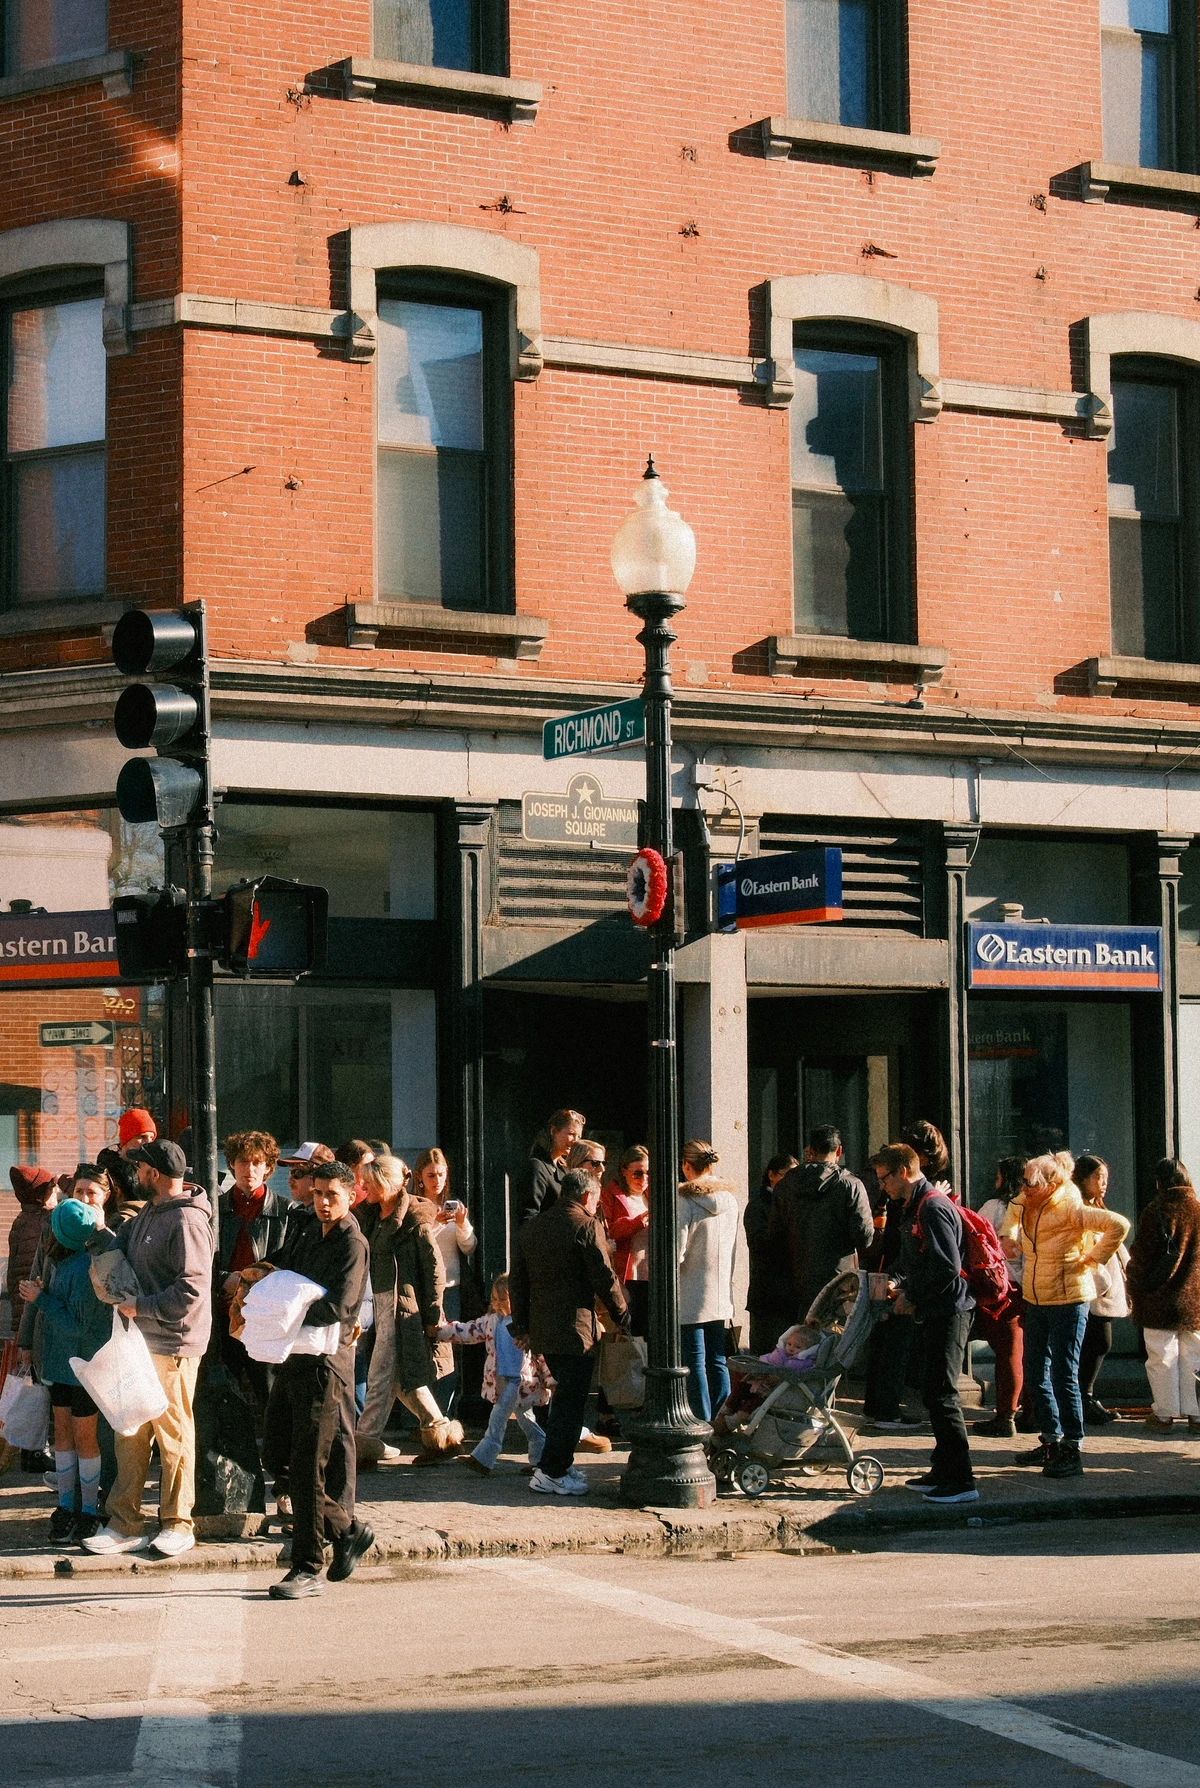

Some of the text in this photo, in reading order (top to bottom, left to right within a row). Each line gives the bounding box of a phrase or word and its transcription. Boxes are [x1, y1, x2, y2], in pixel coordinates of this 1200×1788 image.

[554, 709, 635, 755] RICHMOND ST
[528, 802, 568, 818] JOSEPH
[571, 805, 580, 819] J.
[565, 821, 606, 837] SQUARE
[753, 873, 819, 896] Eastern Bank
[73, 931, 117, 954] Ban
[1006, 940, 1155, 966] Eastern Bank
[995, 1028, 1031, 1042] Bank
